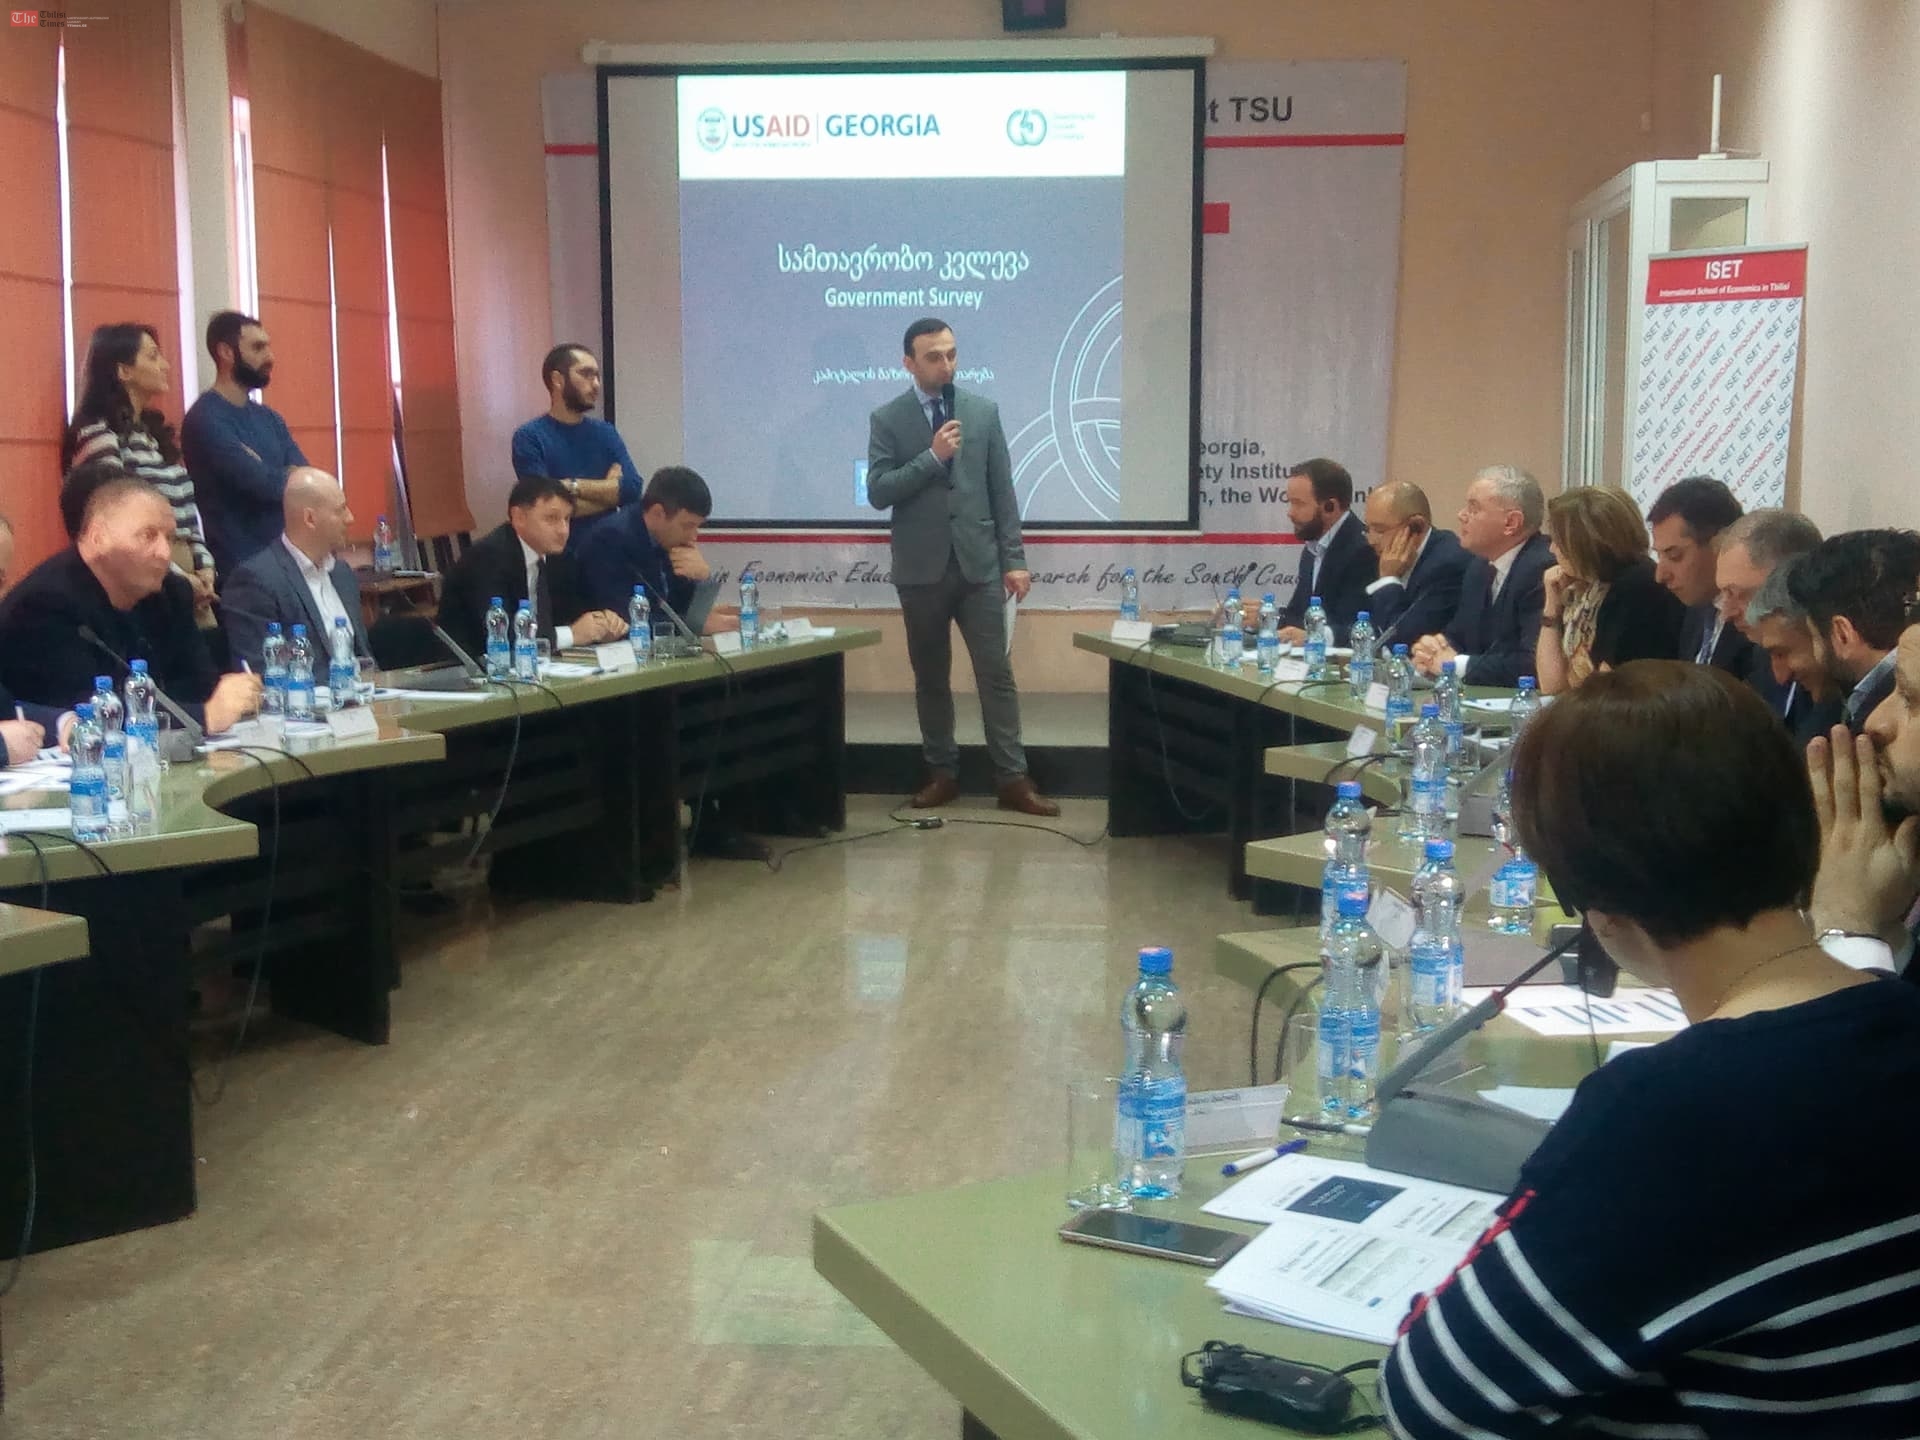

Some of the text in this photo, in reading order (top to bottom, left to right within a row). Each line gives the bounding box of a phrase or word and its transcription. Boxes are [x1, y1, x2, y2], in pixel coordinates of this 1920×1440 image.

[1229, 96, 1293, 122] TSU
[732, 113, 941, 138] USAID GEORGIA
[777, 242, 1030, 281] სამთავრობო კვლევა
[1705, 259, 1743, 280] ISET
[824, 287, 983, 311] Government Survey
[1200, 438, 1265, 459] eorgia,
[1220, 487, 1251, 503] the
[1142, 563, 1176, 584] the
